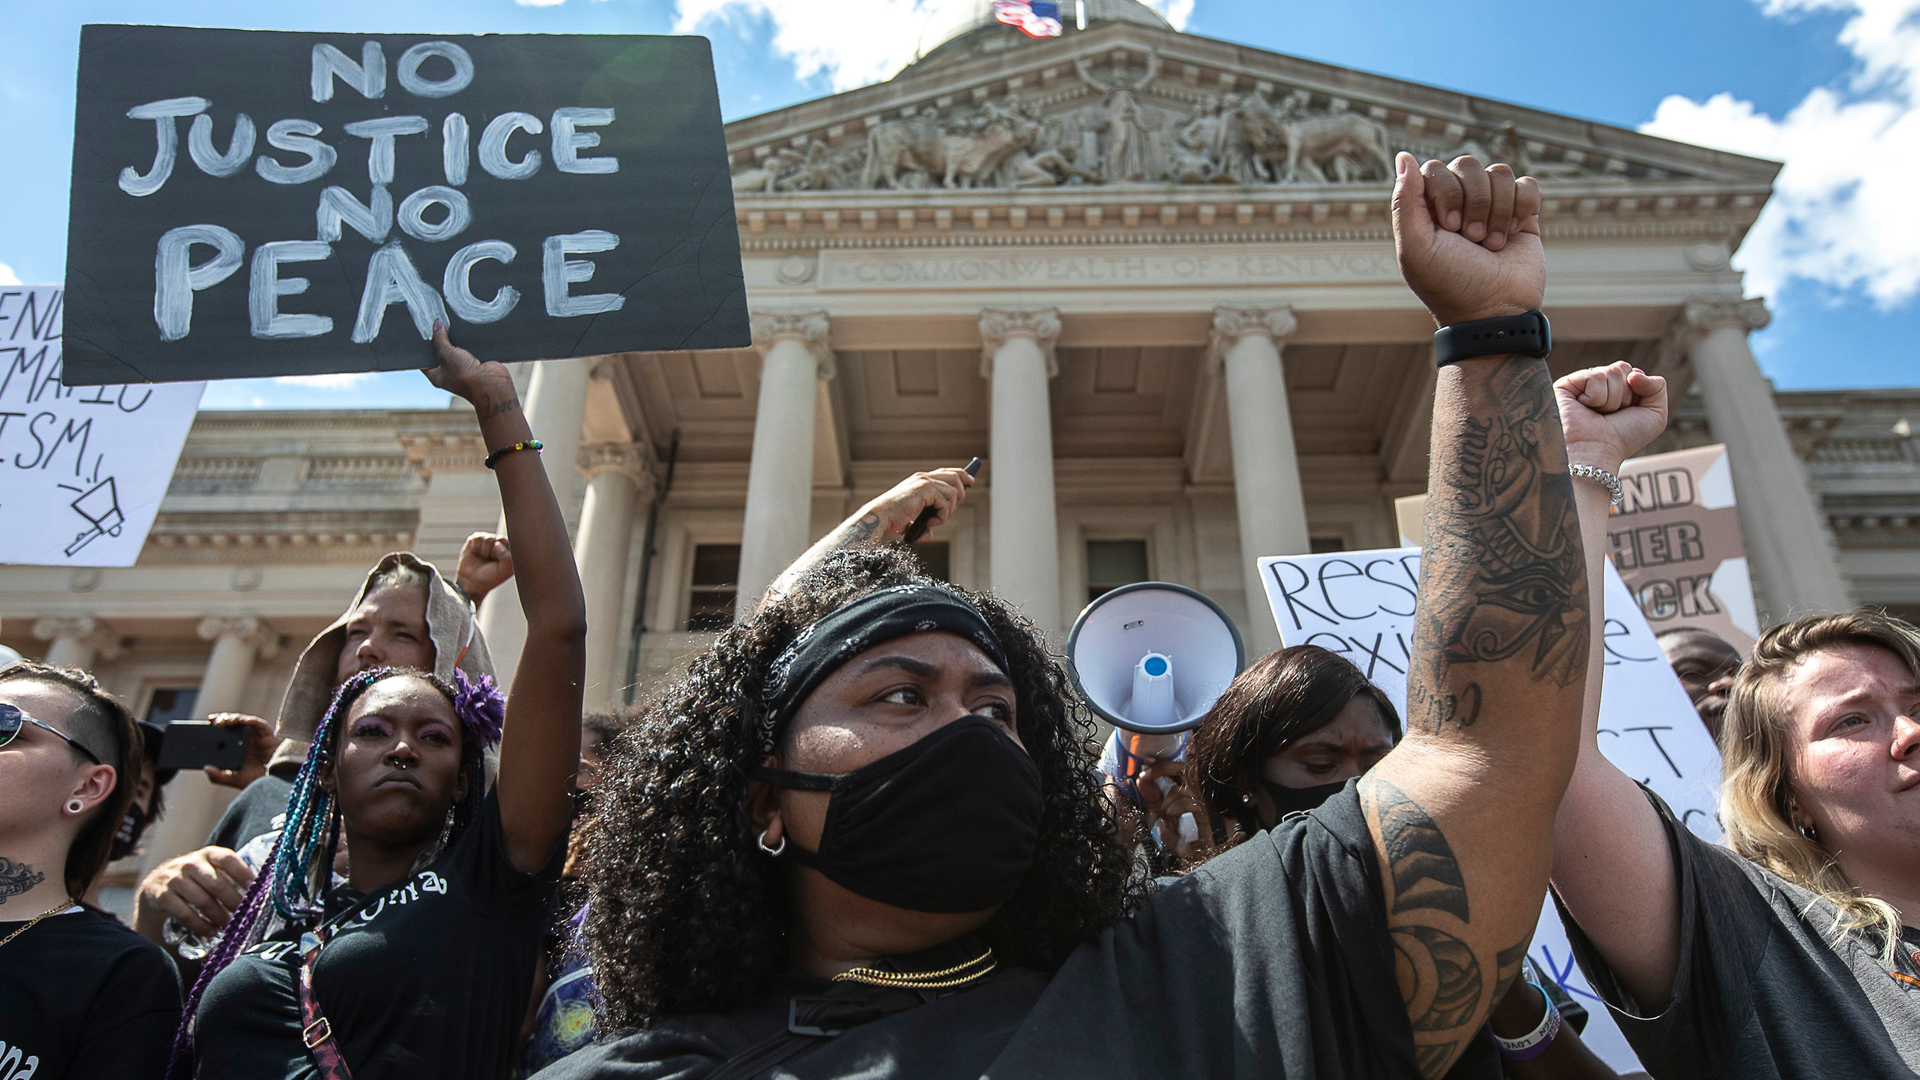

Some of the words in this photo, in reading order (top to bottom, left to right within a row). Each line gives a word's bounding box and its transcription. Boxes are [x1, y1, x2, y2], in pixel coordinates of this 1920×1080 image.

[311, 41, 475, 103] NO
[119, 97, 619, 196] JUSTICE
[317, 184, 472, 244] NO
[154, 224, 625, 343] PEACE
[855, 256, 1147, 283] COMMONWEALTH
[1171, 256, 1209, 279] OF
[1237, 254, 1393, 278] KENTVCK
[1609, 467, 1694, 518] ND
[1626, 573, 1721, 622] CK
